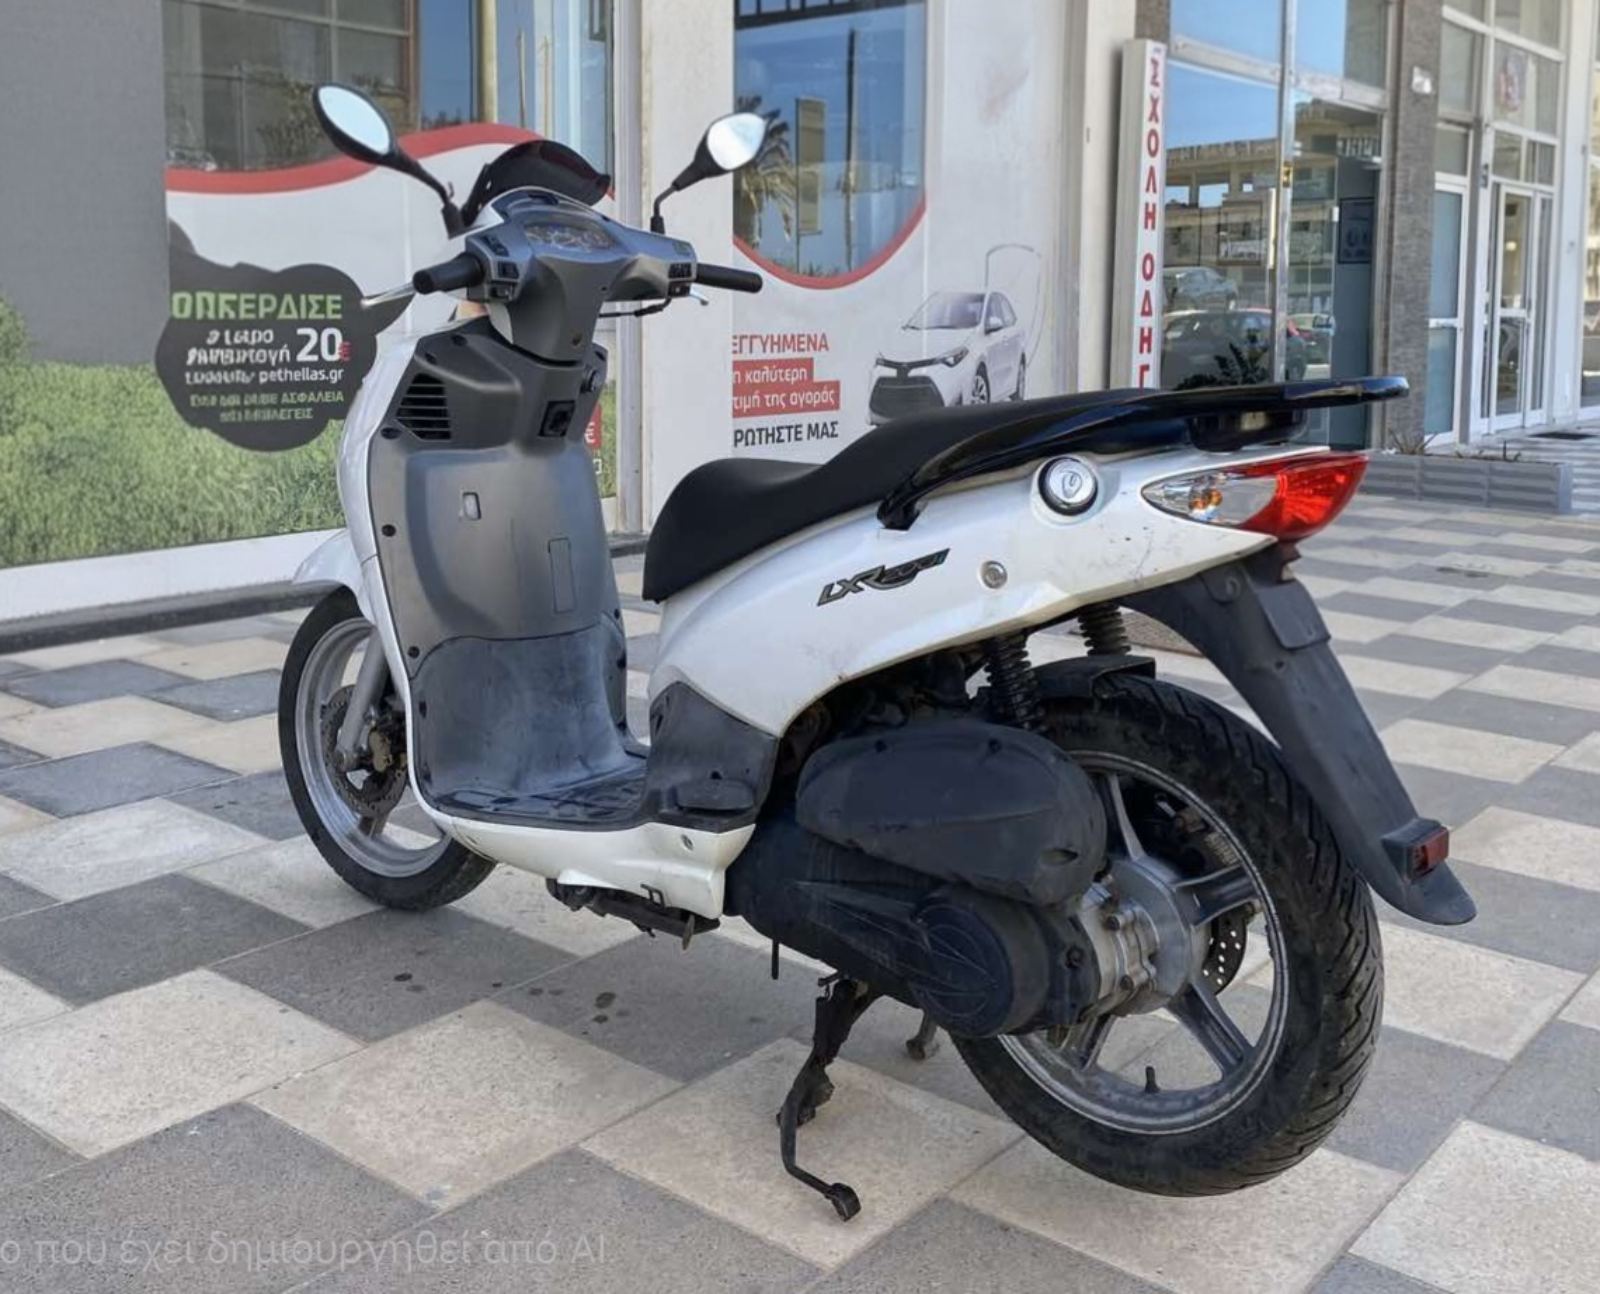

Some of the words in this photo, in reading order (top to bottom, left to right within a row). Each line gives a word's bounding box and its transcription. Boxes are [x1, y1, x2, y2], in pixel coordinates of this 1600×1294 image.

[1143, 58, 1161, 230] ΣΧΟΛΗ
[259, 367, 344, 384] pethellas.gr
[745, 364, 808, 385] καλύτερη
[280, 391, 345, 404] ΑΣΦΑΛΕΙΑ
[733, 391, 760, 413] τιμή
[764, 392, 786, 409] της
[789, 384, 836, 409] αγοράς
[733, 424, 803, 448] ΡΩΤΗΣΤΕ
[806, 421, 839, 440] ΜΑΣ
